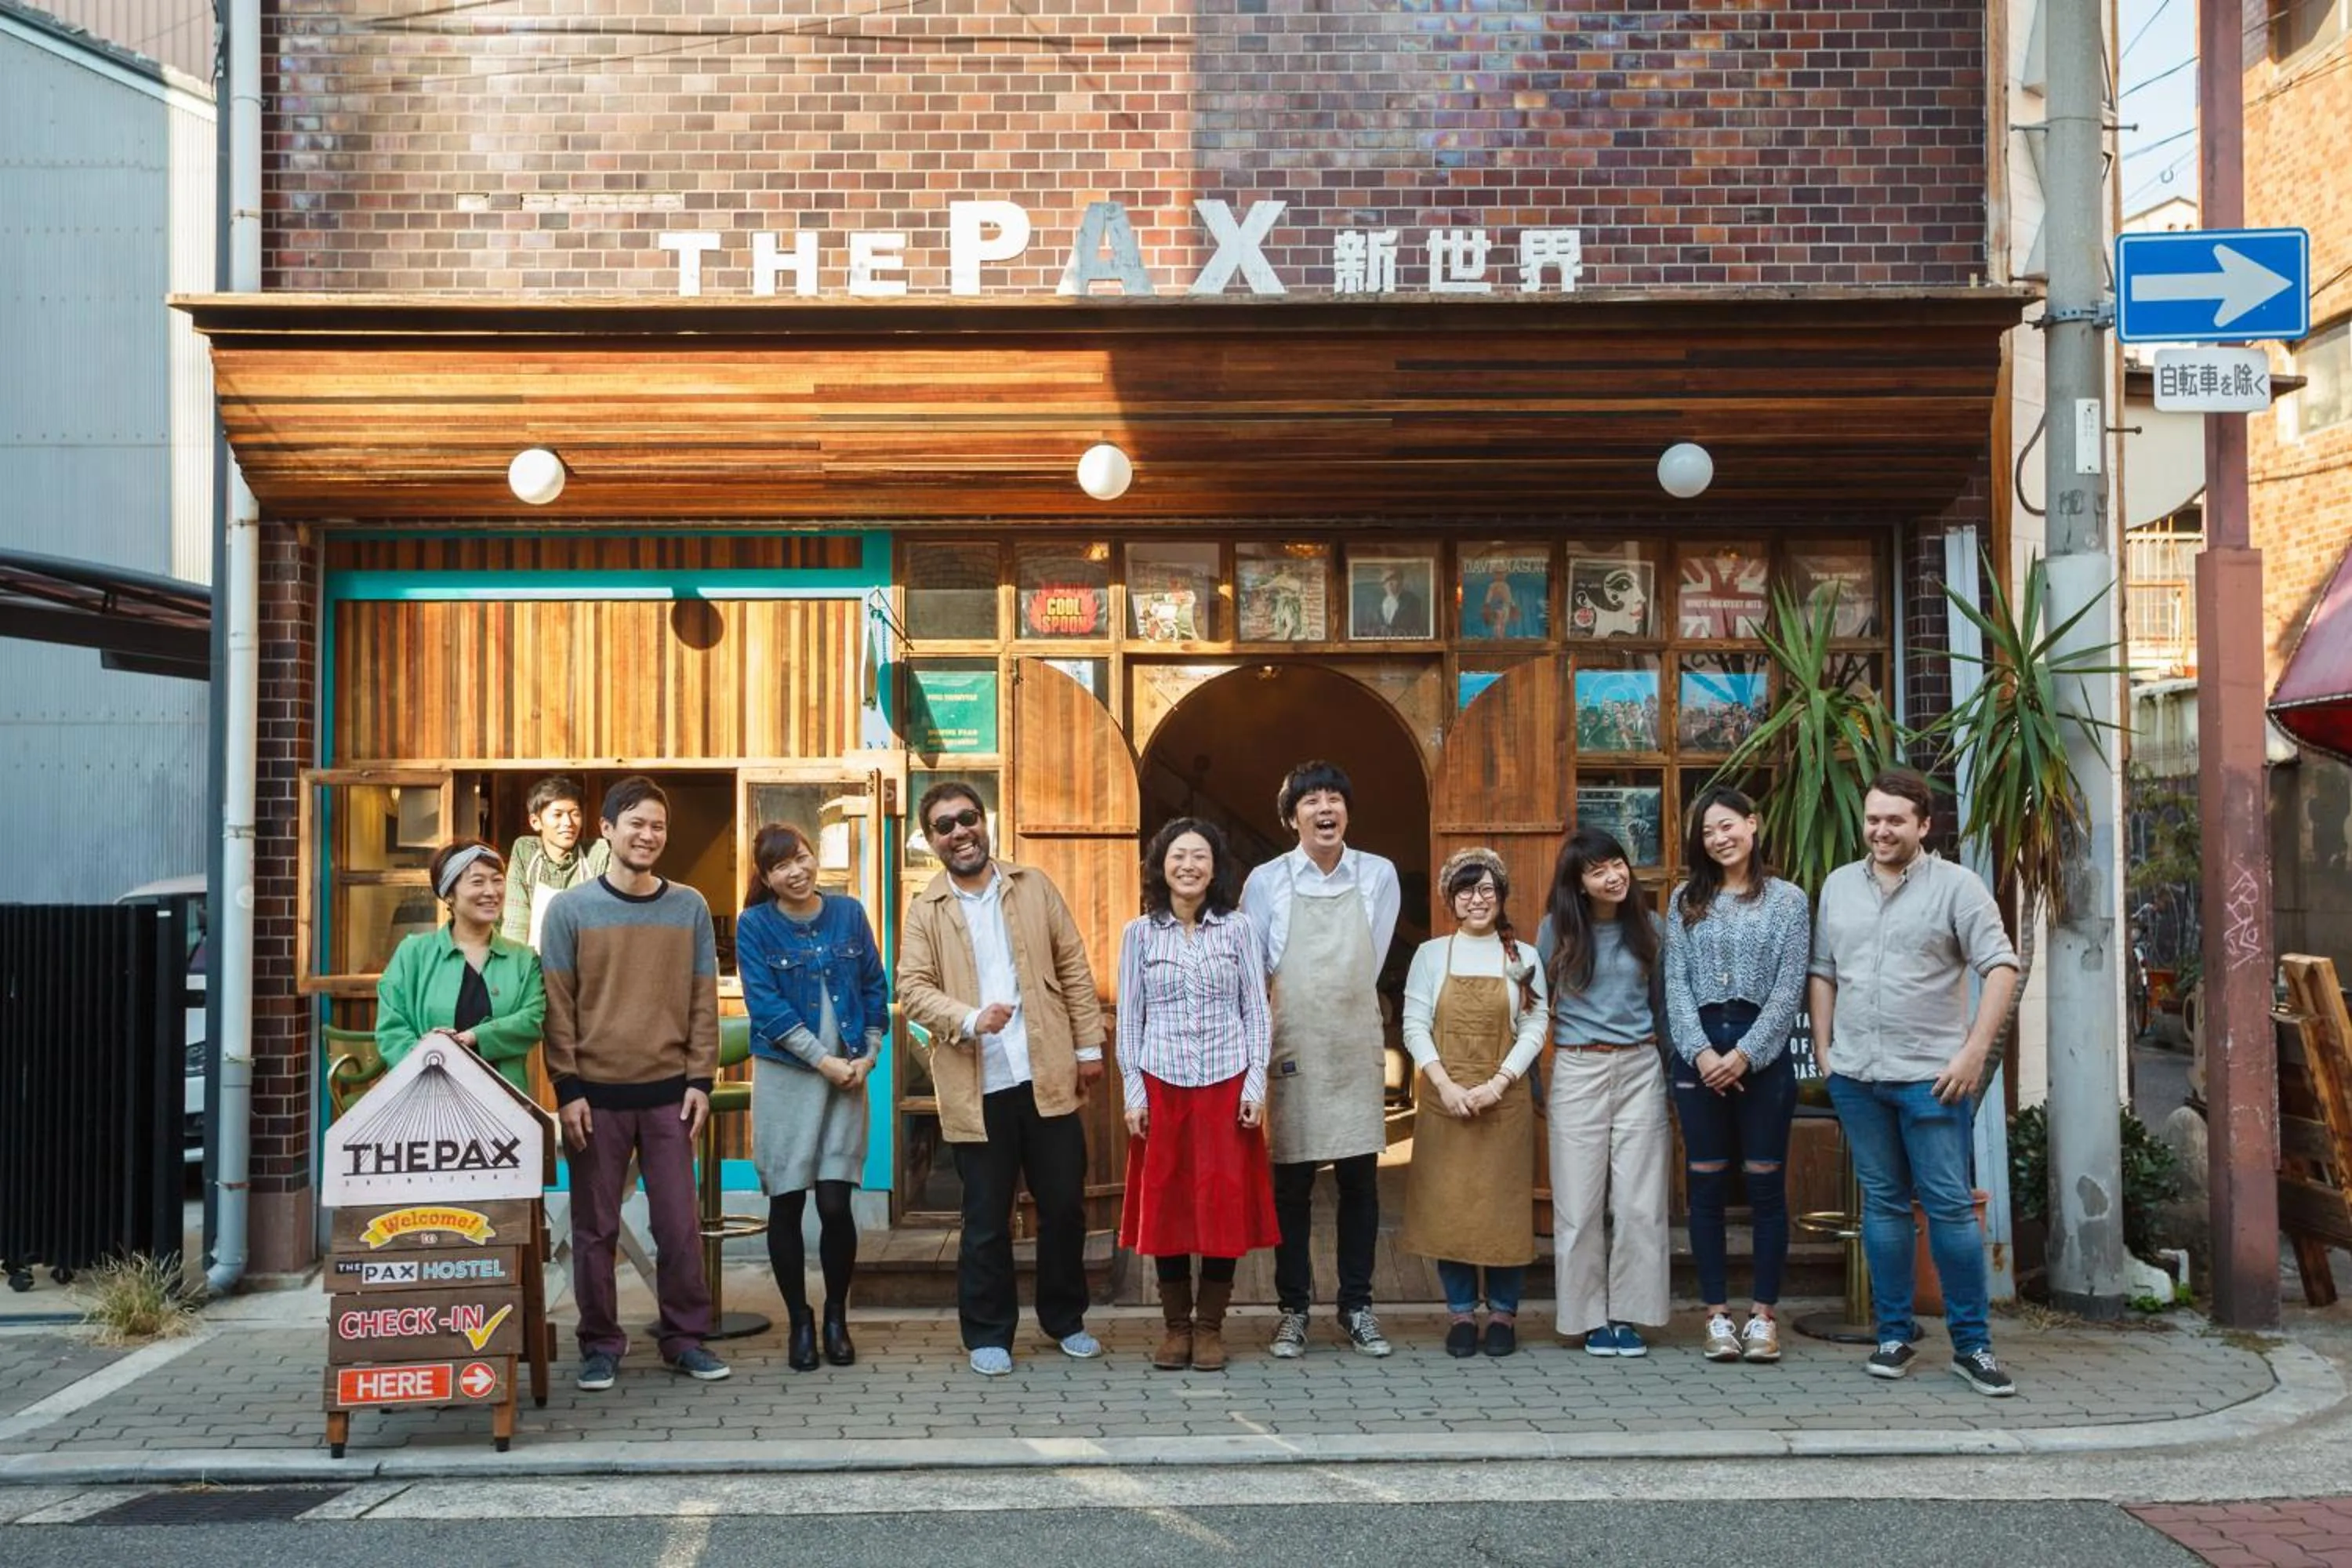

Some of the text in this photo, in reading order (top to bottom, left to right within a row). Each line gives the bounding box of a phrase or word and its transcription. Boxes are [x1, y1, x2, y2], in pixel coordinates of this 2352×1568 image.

[659, 199, 1289, 296] THE PAX
[1334, 229, 1582, 292] 新世界
[2160, 363, 2267, 397] 自転車を除く
[1047, 597, 1080, 615] COOL
[1042, 615, 1087, 633] SPOON
[380, 1211, 481, 1233] Welcome!
[420, 1232, 437, 1244] to
[338, 1258, 506, 1281] THE PAX HOSTEL
[357, 1370, 434, 1399] HERE
